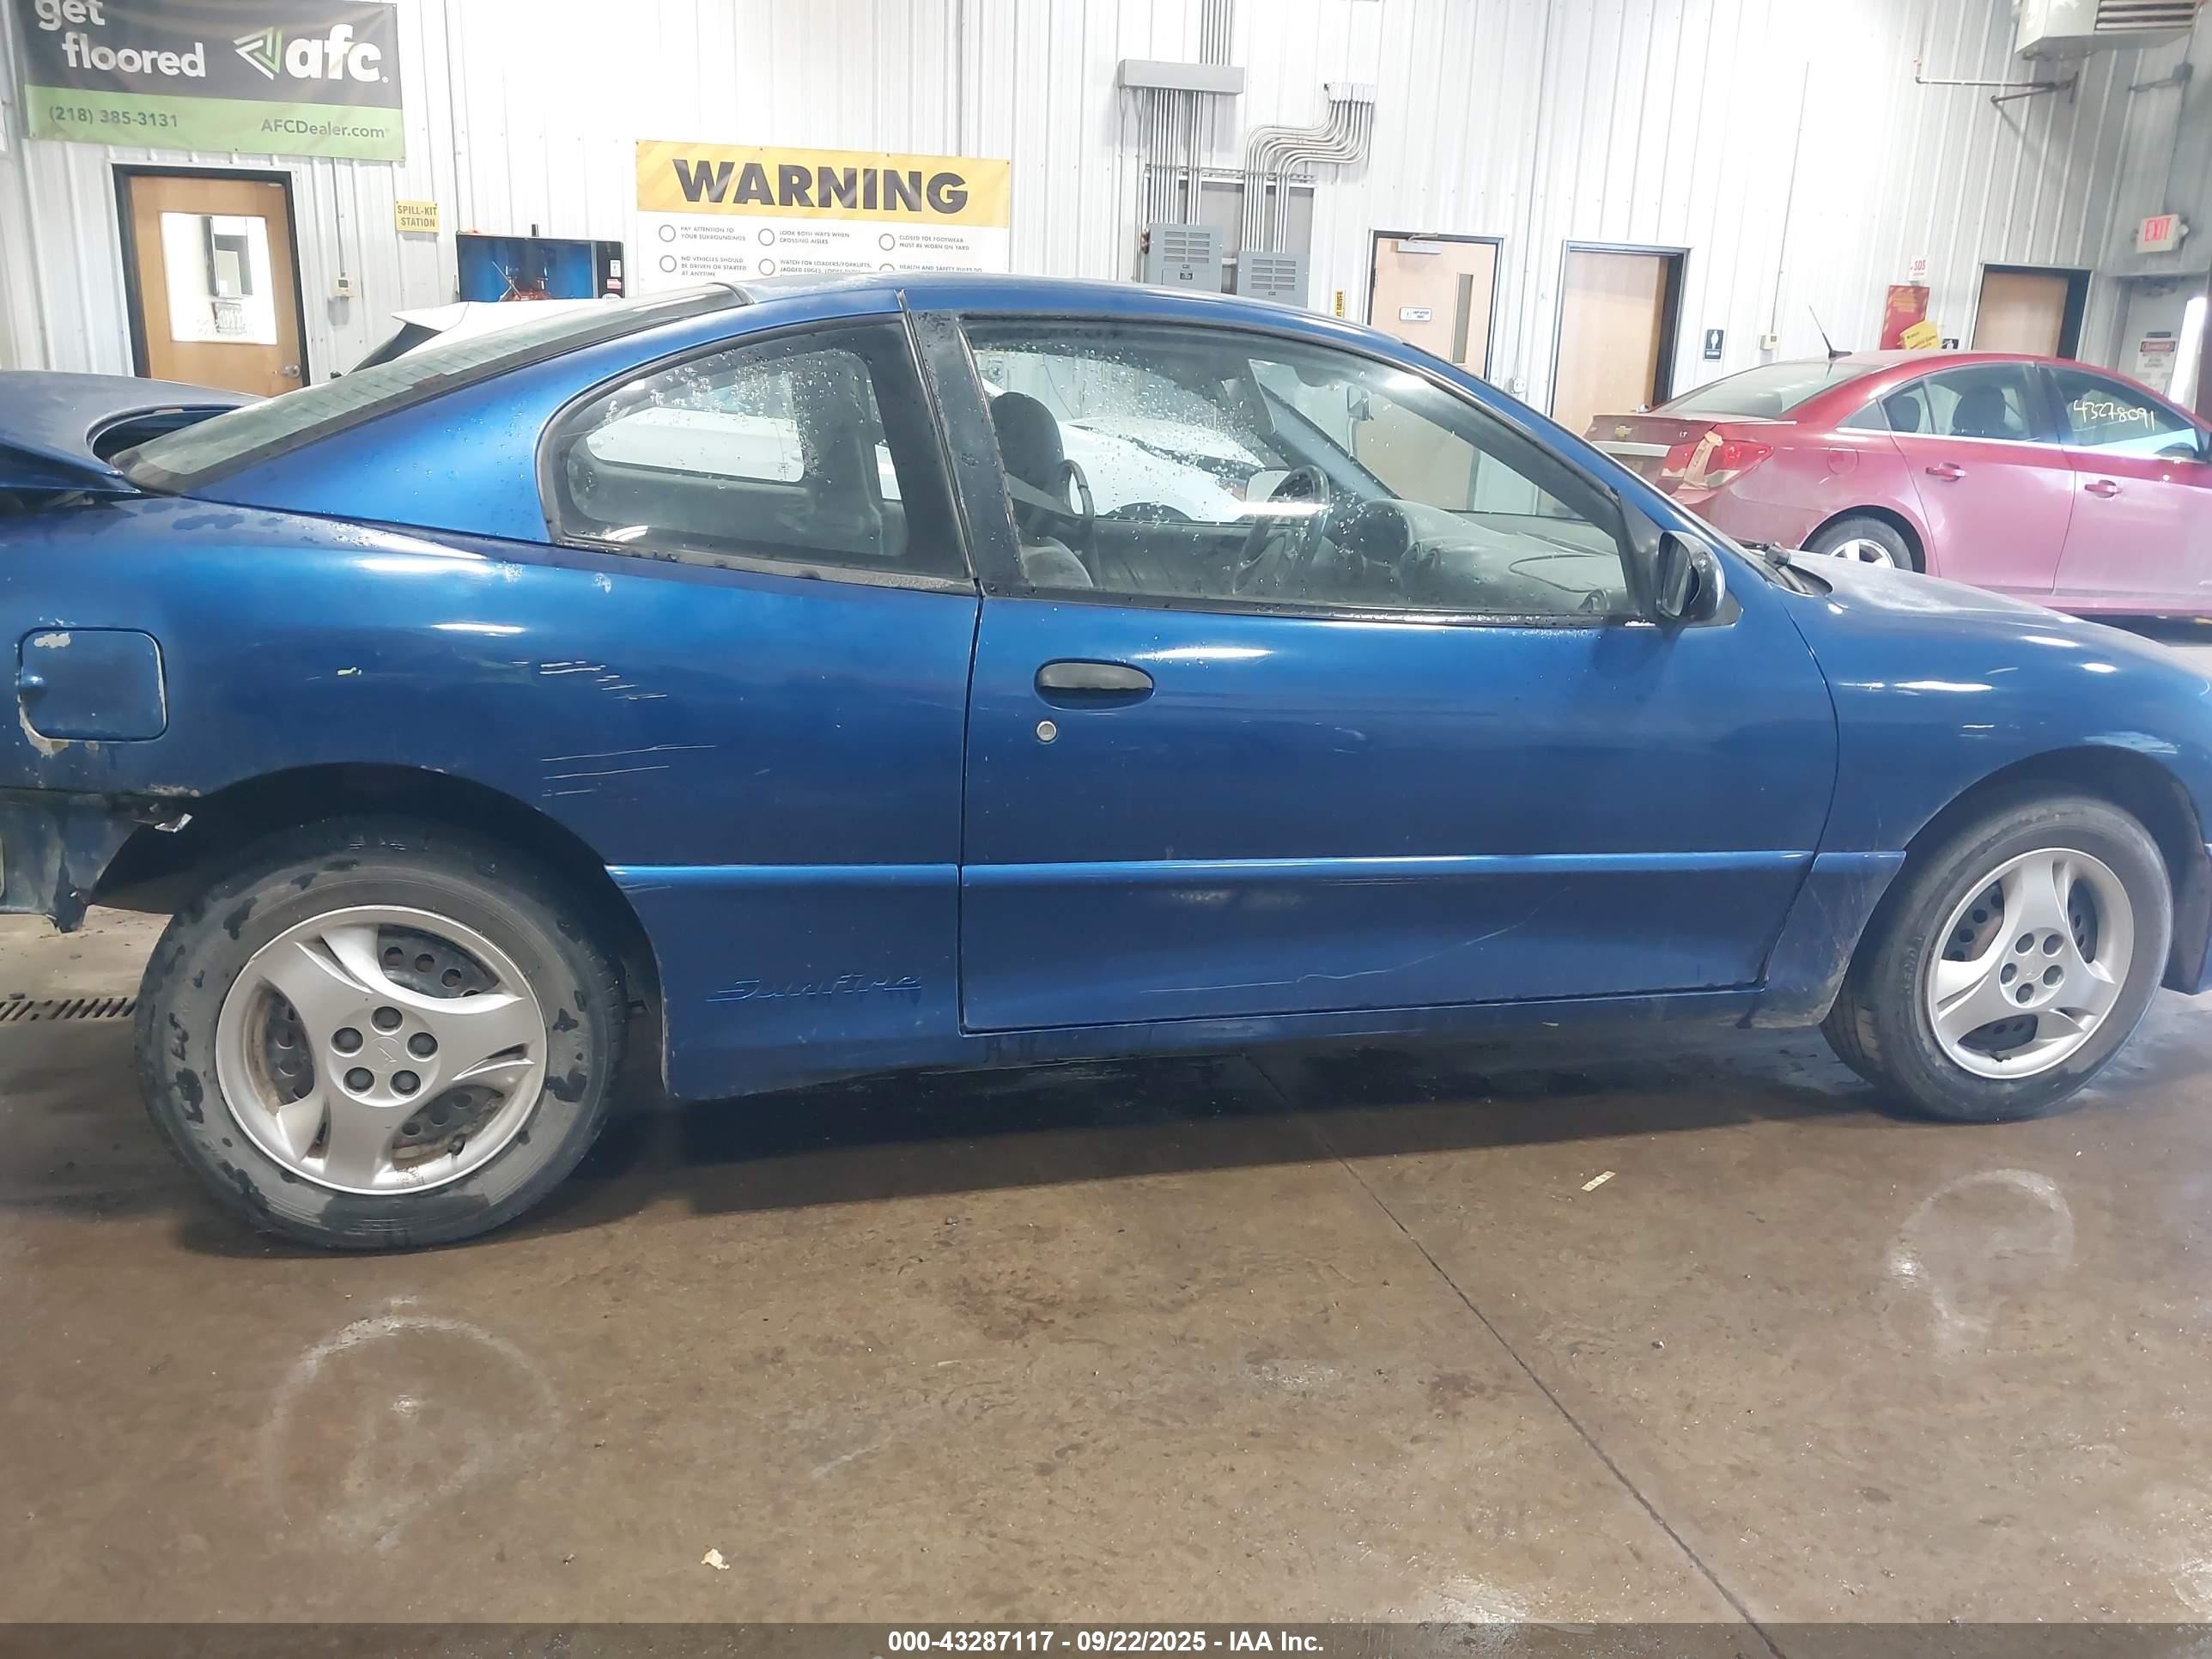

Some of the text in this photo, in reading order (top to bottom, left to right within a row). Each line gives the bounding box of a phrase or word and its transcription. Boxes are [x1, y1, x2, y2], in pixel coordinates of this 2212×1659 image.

[34, 0, 106, 31] get
[61, 31, 206, 77] floored
[49, 106, 178, 127] (218) 385-3131
[261, 118, 385, 138] AFCDealer.com
[672, 158, 969, 215] WARNING
[397, 204, 437, 216] SPILL-KIT
[400, 216, 435, 228] STATION
[2073, 399, 2155, 432] 43278091
